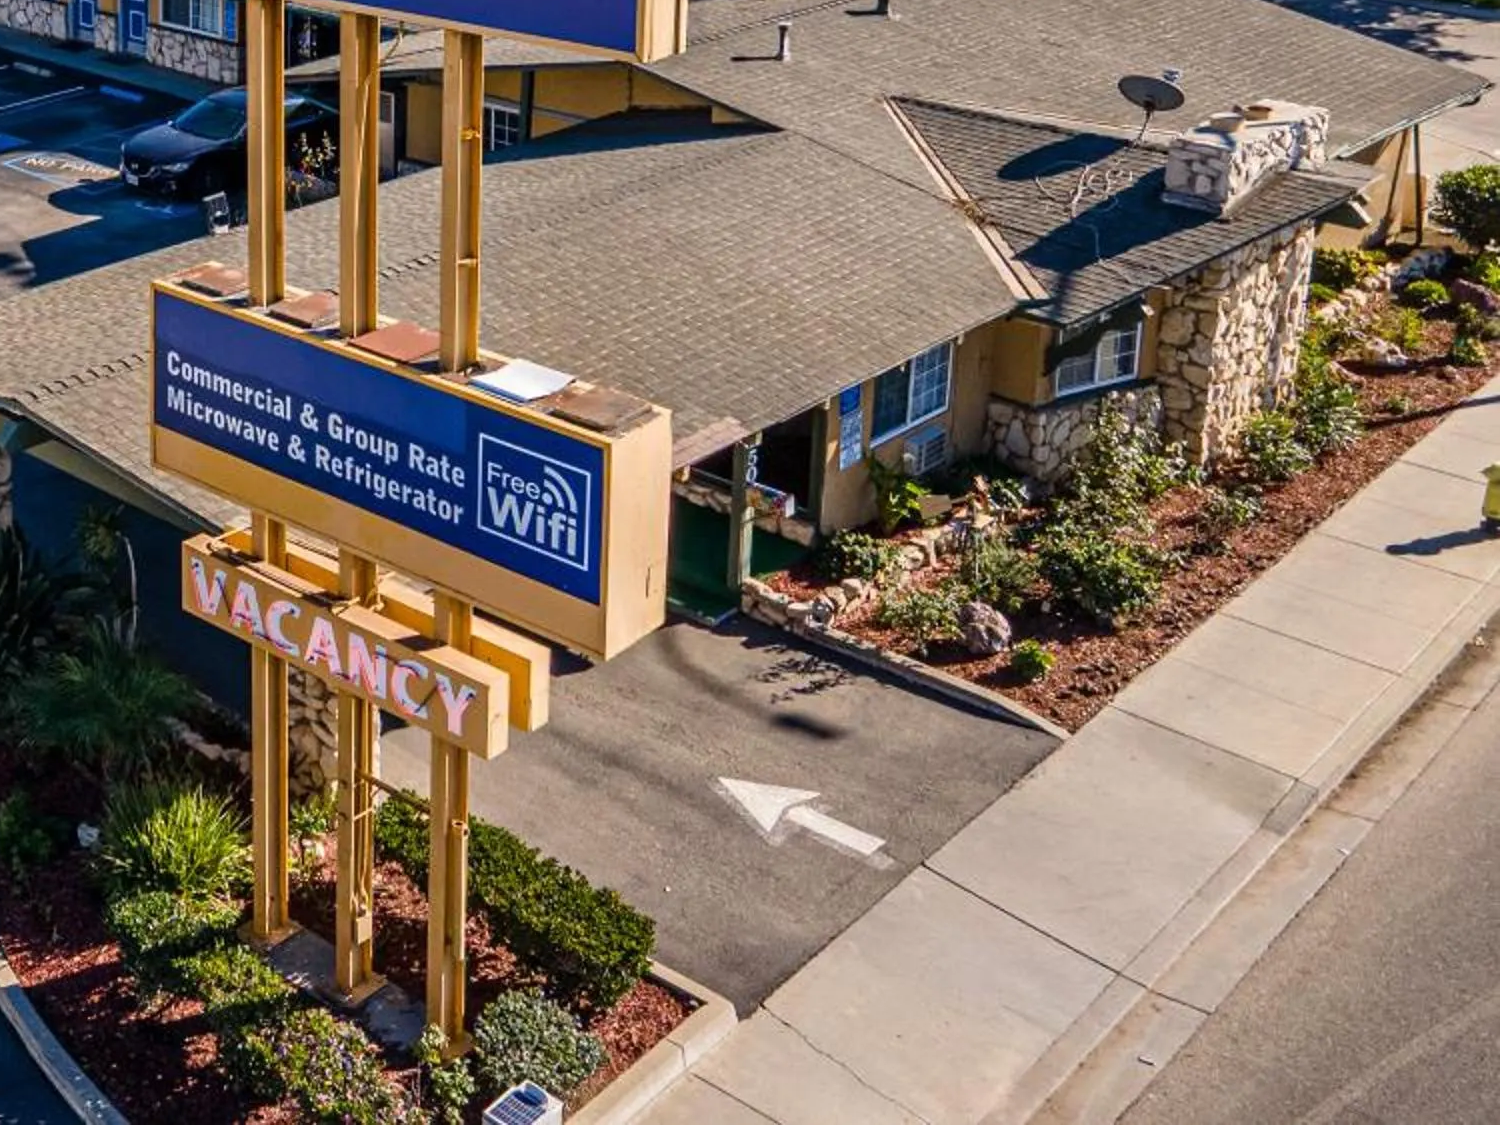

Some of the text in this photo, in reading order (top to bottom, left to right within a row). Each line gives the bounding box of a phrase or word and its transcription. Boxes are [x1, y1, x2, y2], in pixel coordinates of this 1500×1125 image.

[167, 351, 465, 488] Commercial & Group Rate
[167, 385, 464, 525] Microwave & Refrigerator
[487, 461, 542, 500] Free
[487, 486, 578, 557] Wifi
[190, 557, 476, 736] VACANCY
